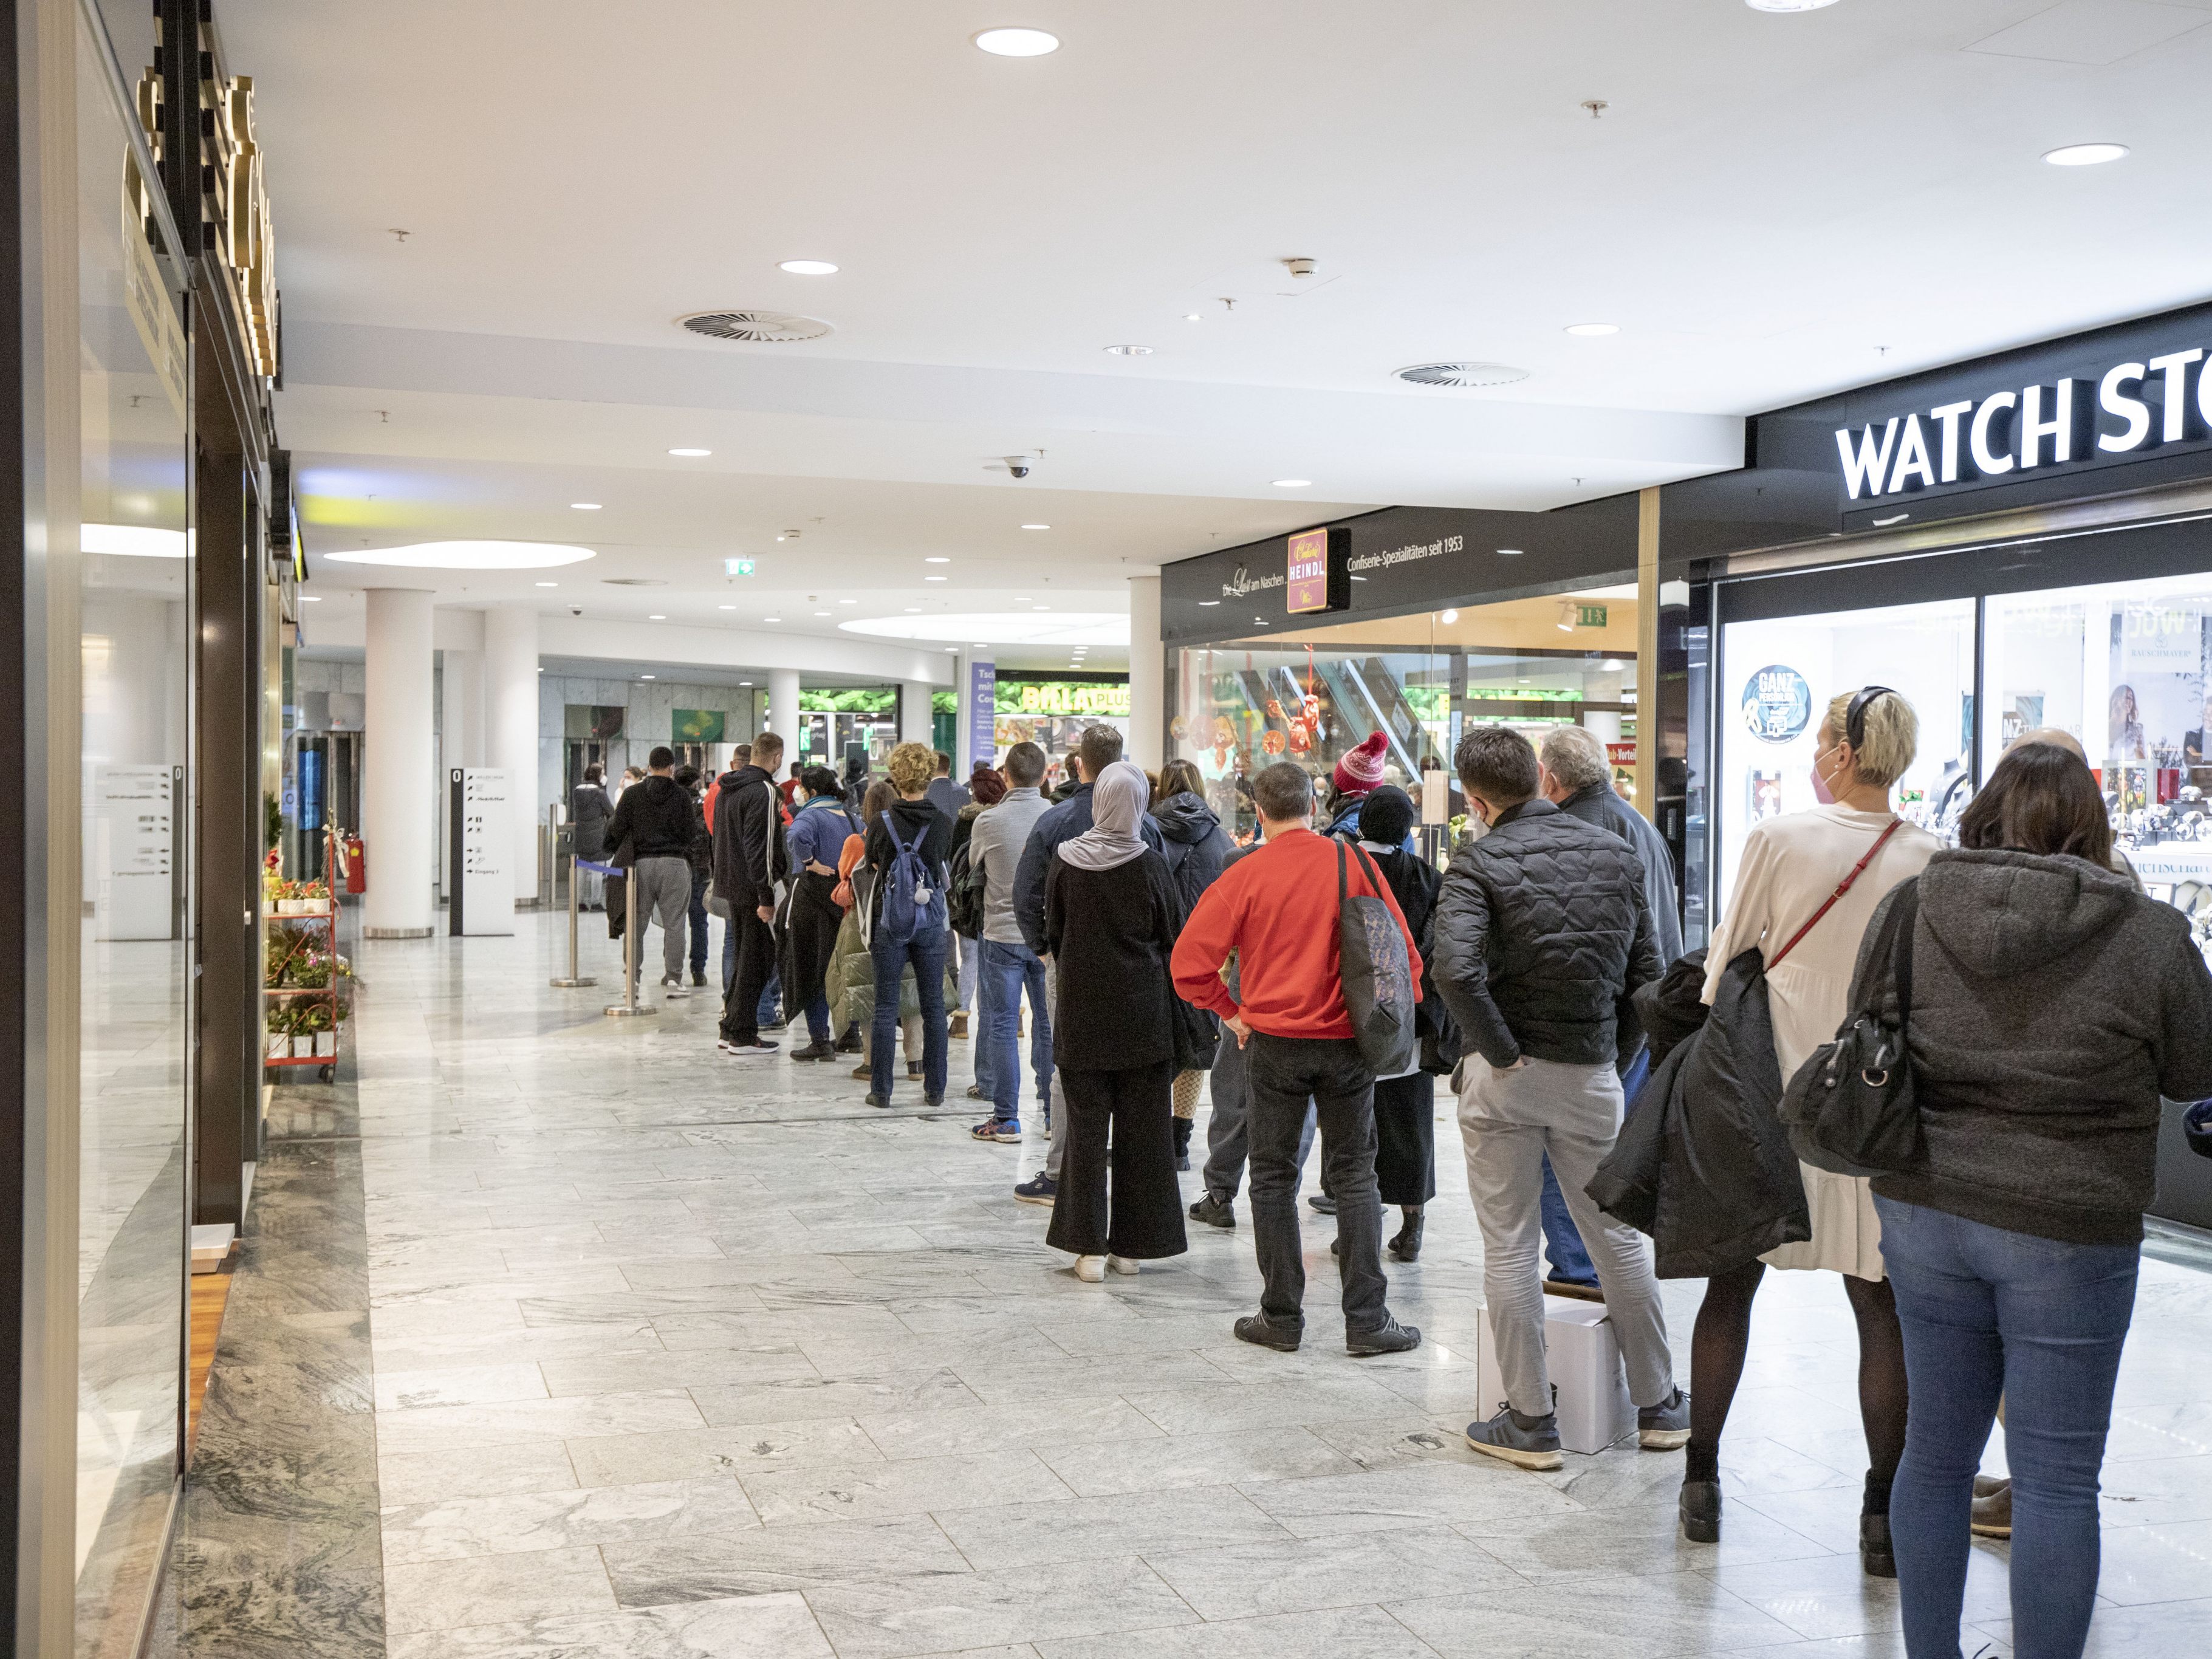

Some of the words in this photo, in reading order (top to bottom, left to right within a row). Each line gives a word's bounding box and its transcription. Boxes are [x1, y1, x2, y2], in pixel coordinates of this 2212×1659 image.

[1835, 378, 2072, 499] WATCH
[1347, 545, 1428, 572] Confiserie-Spezialitäten
[1428, 539, 1443, 556] seit
[1444, 535, 1463, 553] 1953
[1290, 560, 1324, 581] HEINDL
[1252, 580, 1260, 591] am
[1759, 672, 1795, 693] GANZ
[1022, 686, 1091, 711] BILLA
[452, 770, 462, 783] 0
